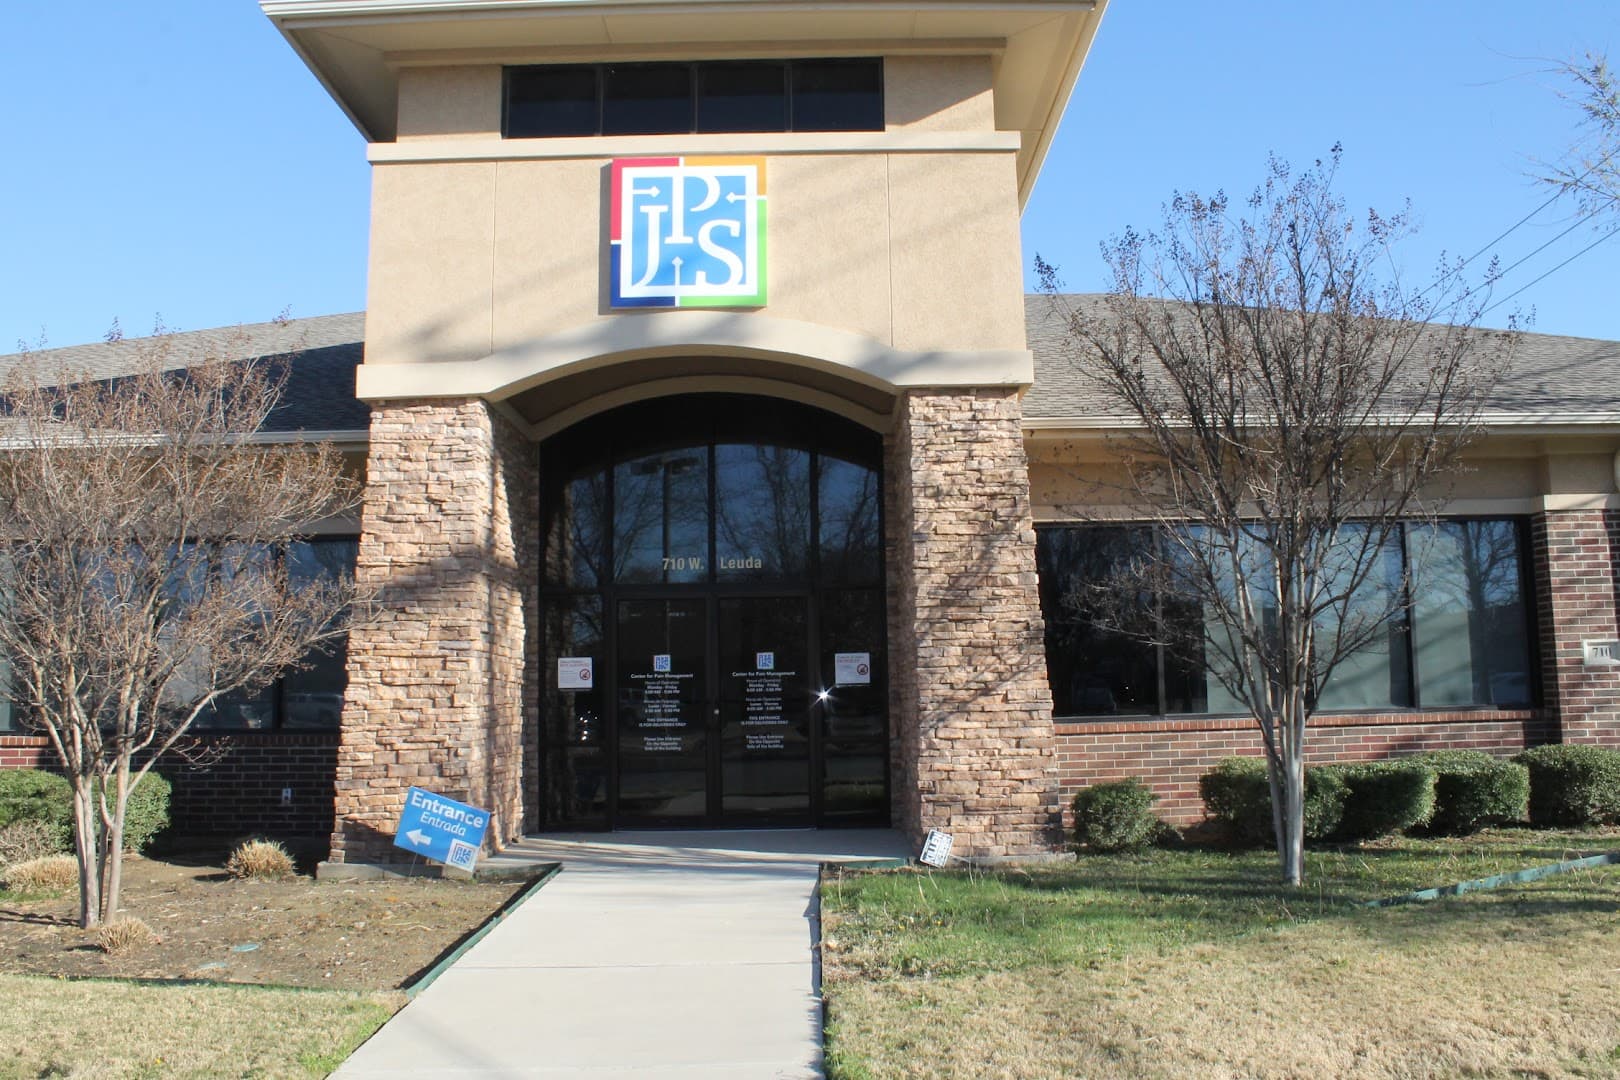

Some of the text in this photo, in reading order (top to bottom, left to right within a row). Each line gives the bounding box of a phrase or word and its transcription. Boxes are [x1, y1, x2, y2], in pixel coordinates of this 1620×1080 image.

[631, 165, 744, 289] JPS
[662, 556, 762, 571] 710 W. Leuda
[410, 791, 484, 828] Entrance
[420, 812, 466, 837] Entrada
